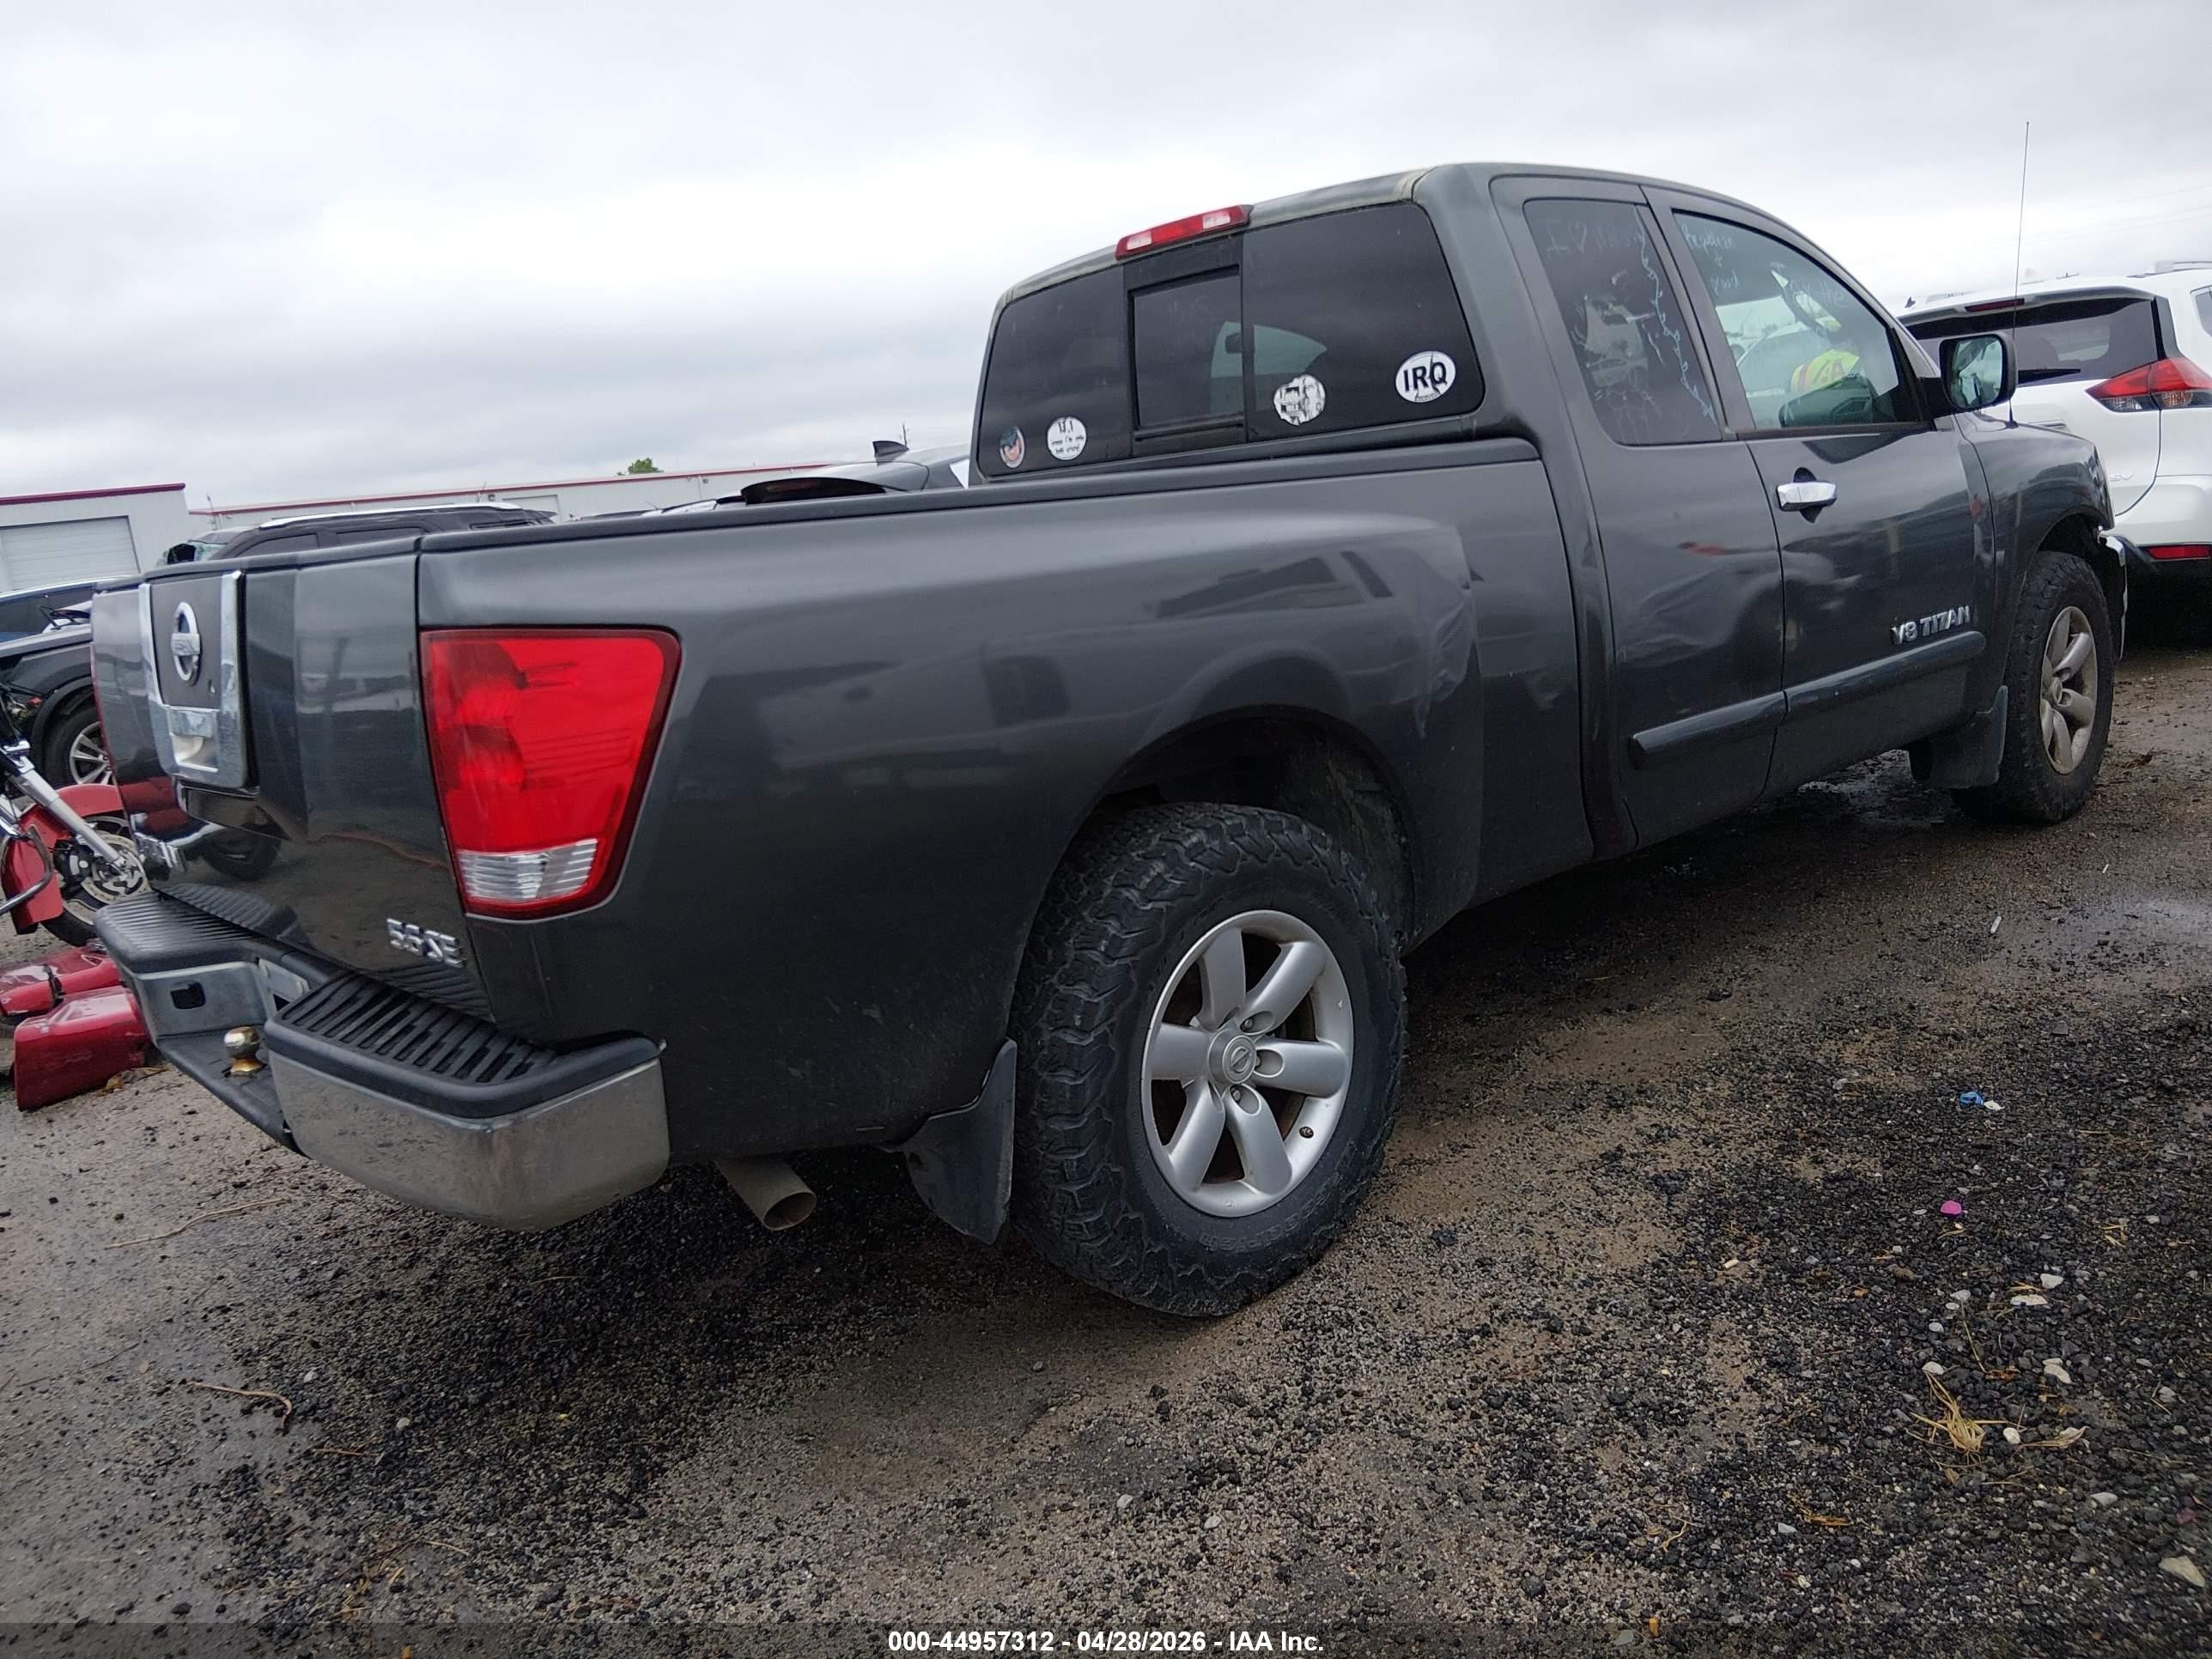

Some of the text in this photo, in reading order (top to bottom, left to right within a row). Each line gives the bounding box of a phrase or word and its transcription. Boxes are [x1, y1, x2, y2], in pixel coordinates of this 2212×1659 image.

[1402, 362, 1449, 392] IRQ
[2109, 473, 2135, 482] SV
[1890, 605, 1971, 645] V8 TITAN
